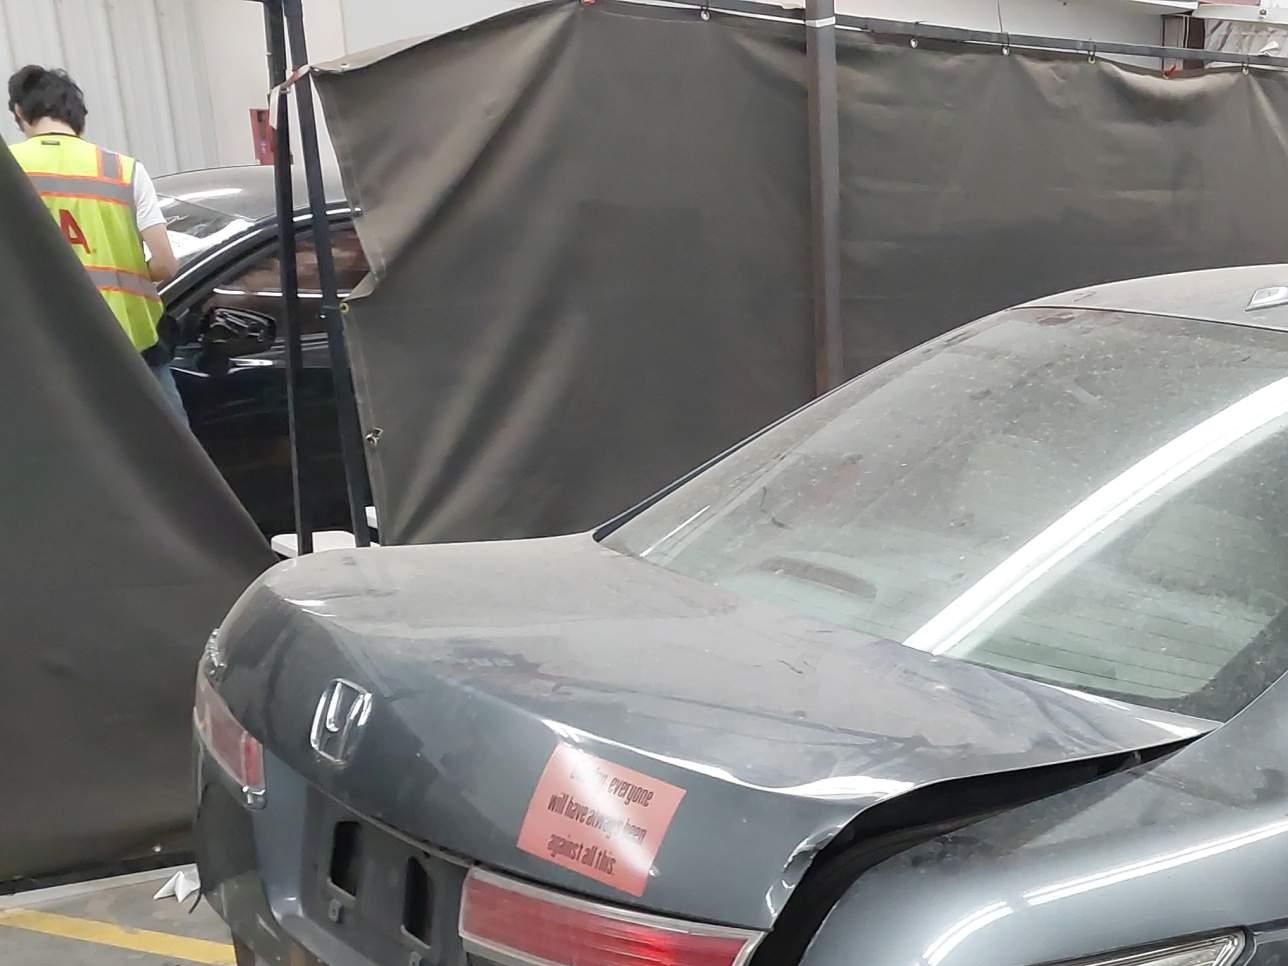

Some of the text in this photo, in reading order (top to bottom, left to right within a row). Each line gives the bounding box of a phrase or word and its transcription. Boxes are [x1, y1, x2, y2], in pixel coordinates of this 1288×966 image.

[608, 777, 654, 807] everyone
[547, 793, 570, 815] will
[564, 796, 589, 824] have
[547, 834, 584, 861] against
[581, 845, 598, 867] all
